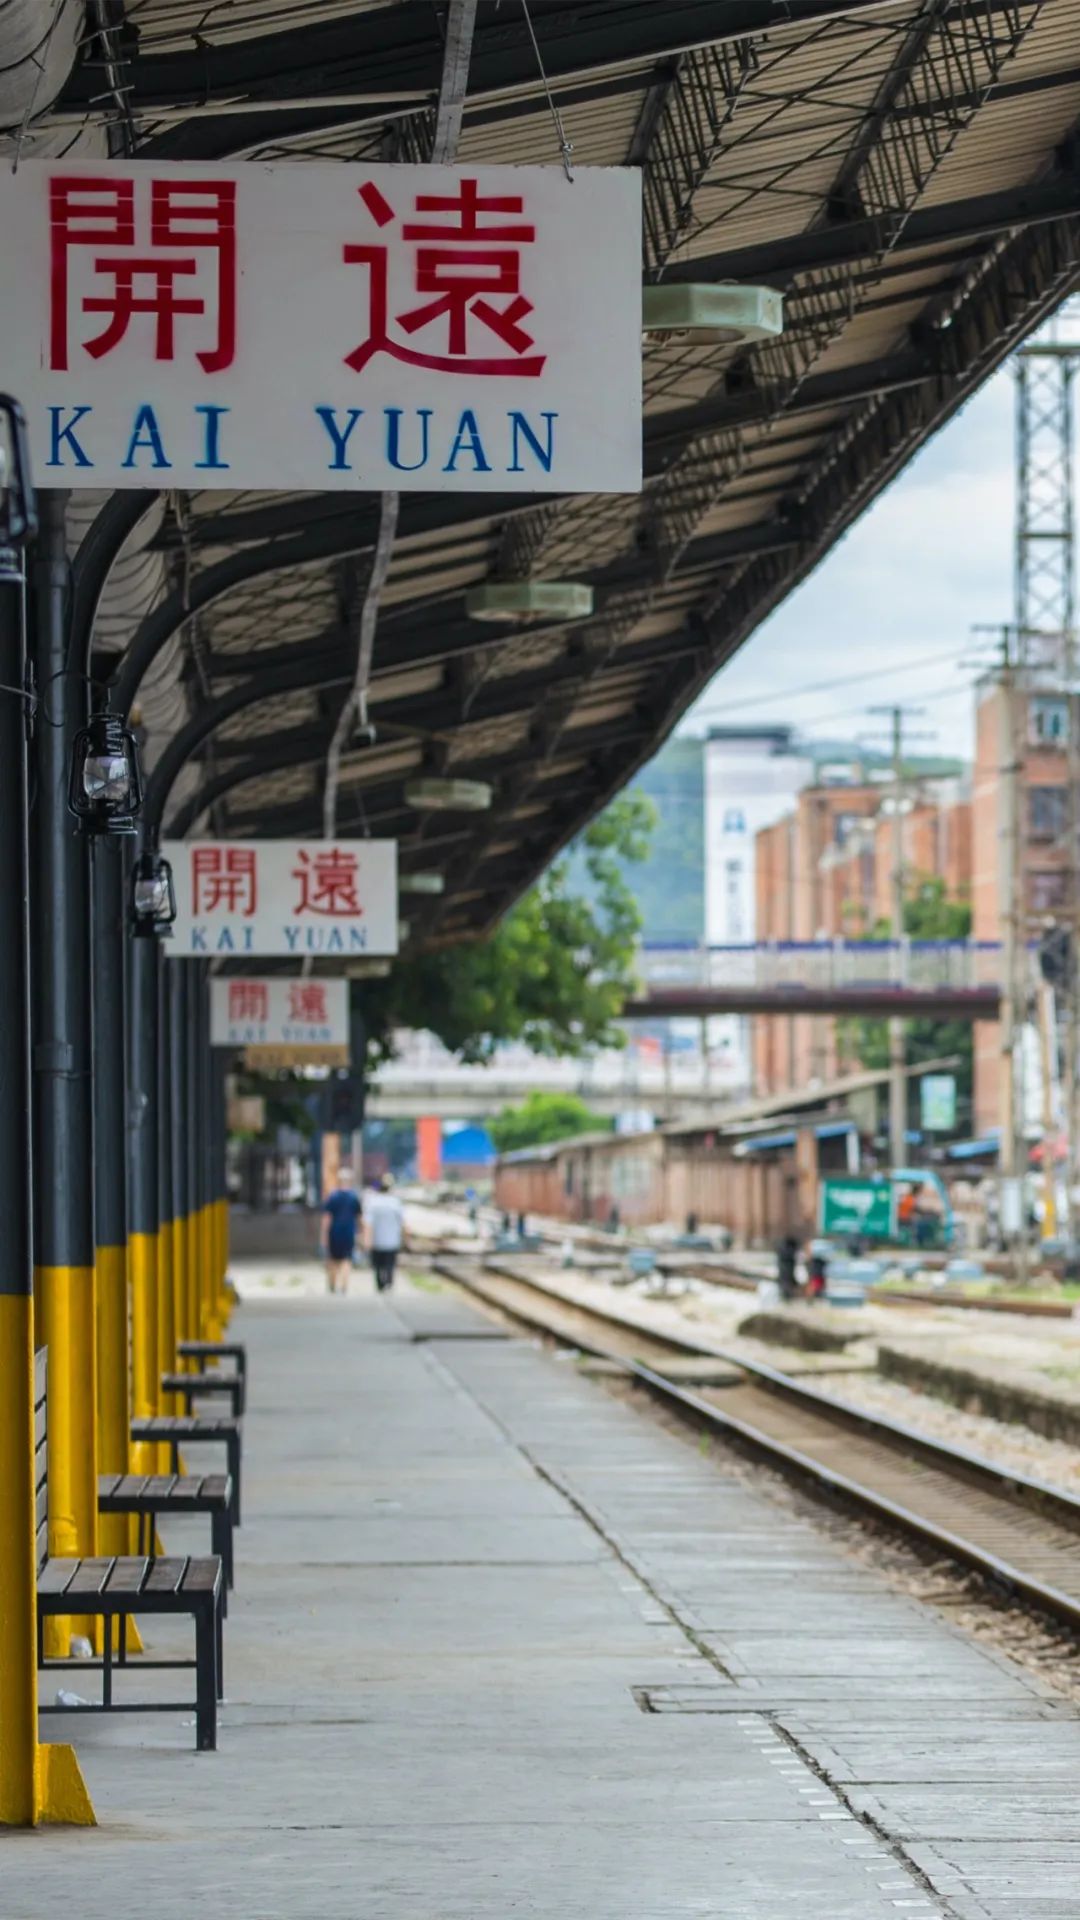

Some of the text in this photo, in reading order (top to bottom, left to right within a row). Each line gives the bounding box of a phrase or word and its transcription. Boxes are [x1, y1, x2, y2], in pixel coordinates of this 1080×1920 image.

[49, 177, 547, 377] 開遠
[46, 404, 559, 472] KAI YUAN
[191, 847, 363, 917] 開遠
[191, 926, 368, 949] KAI YUAN
